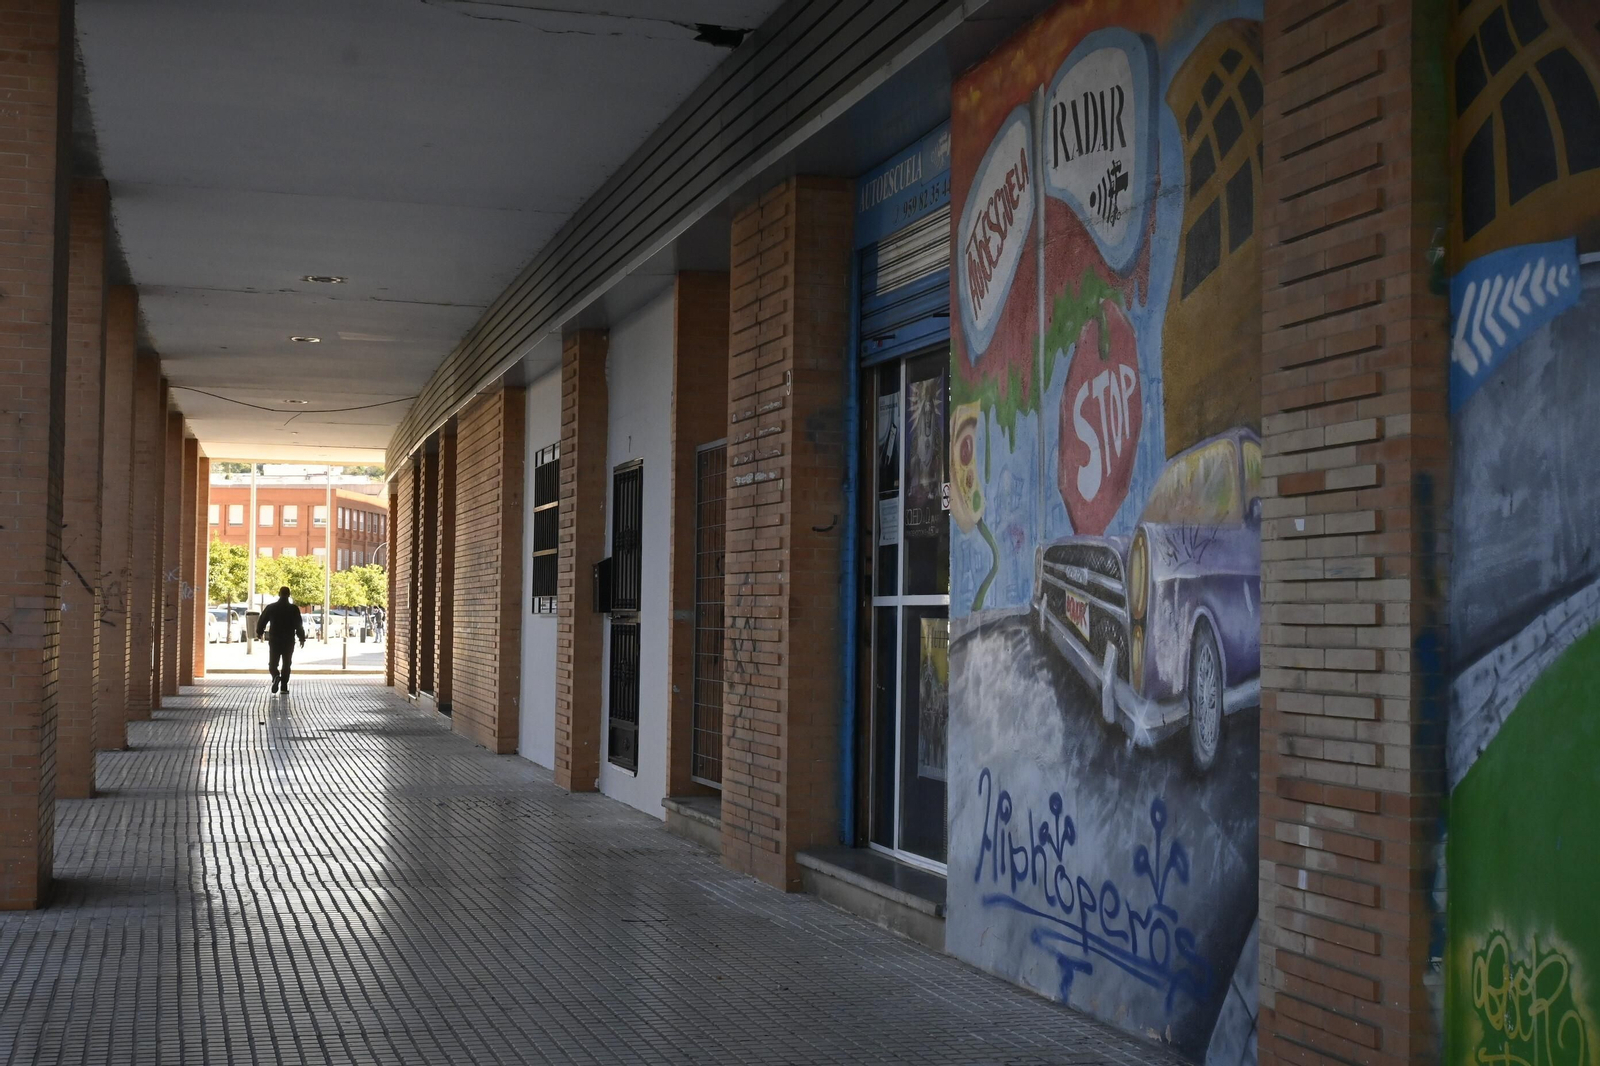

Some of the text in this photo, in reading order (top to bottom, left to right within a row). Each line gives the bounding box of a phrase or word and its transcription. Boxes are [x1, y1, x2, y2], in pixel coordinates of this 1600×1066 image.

[1052, 84, 1127, 169] RADAR
[859, 151, 922, 212] AUTOESCUELA
[903, 196, 917, 220] 959
[919, 189, 928, 211] 82
[930, 182, 939, 205] 35
[966, 147, 1029, 320] AUTOESCUELA
[1073, 363, 1137, 502] STOP
